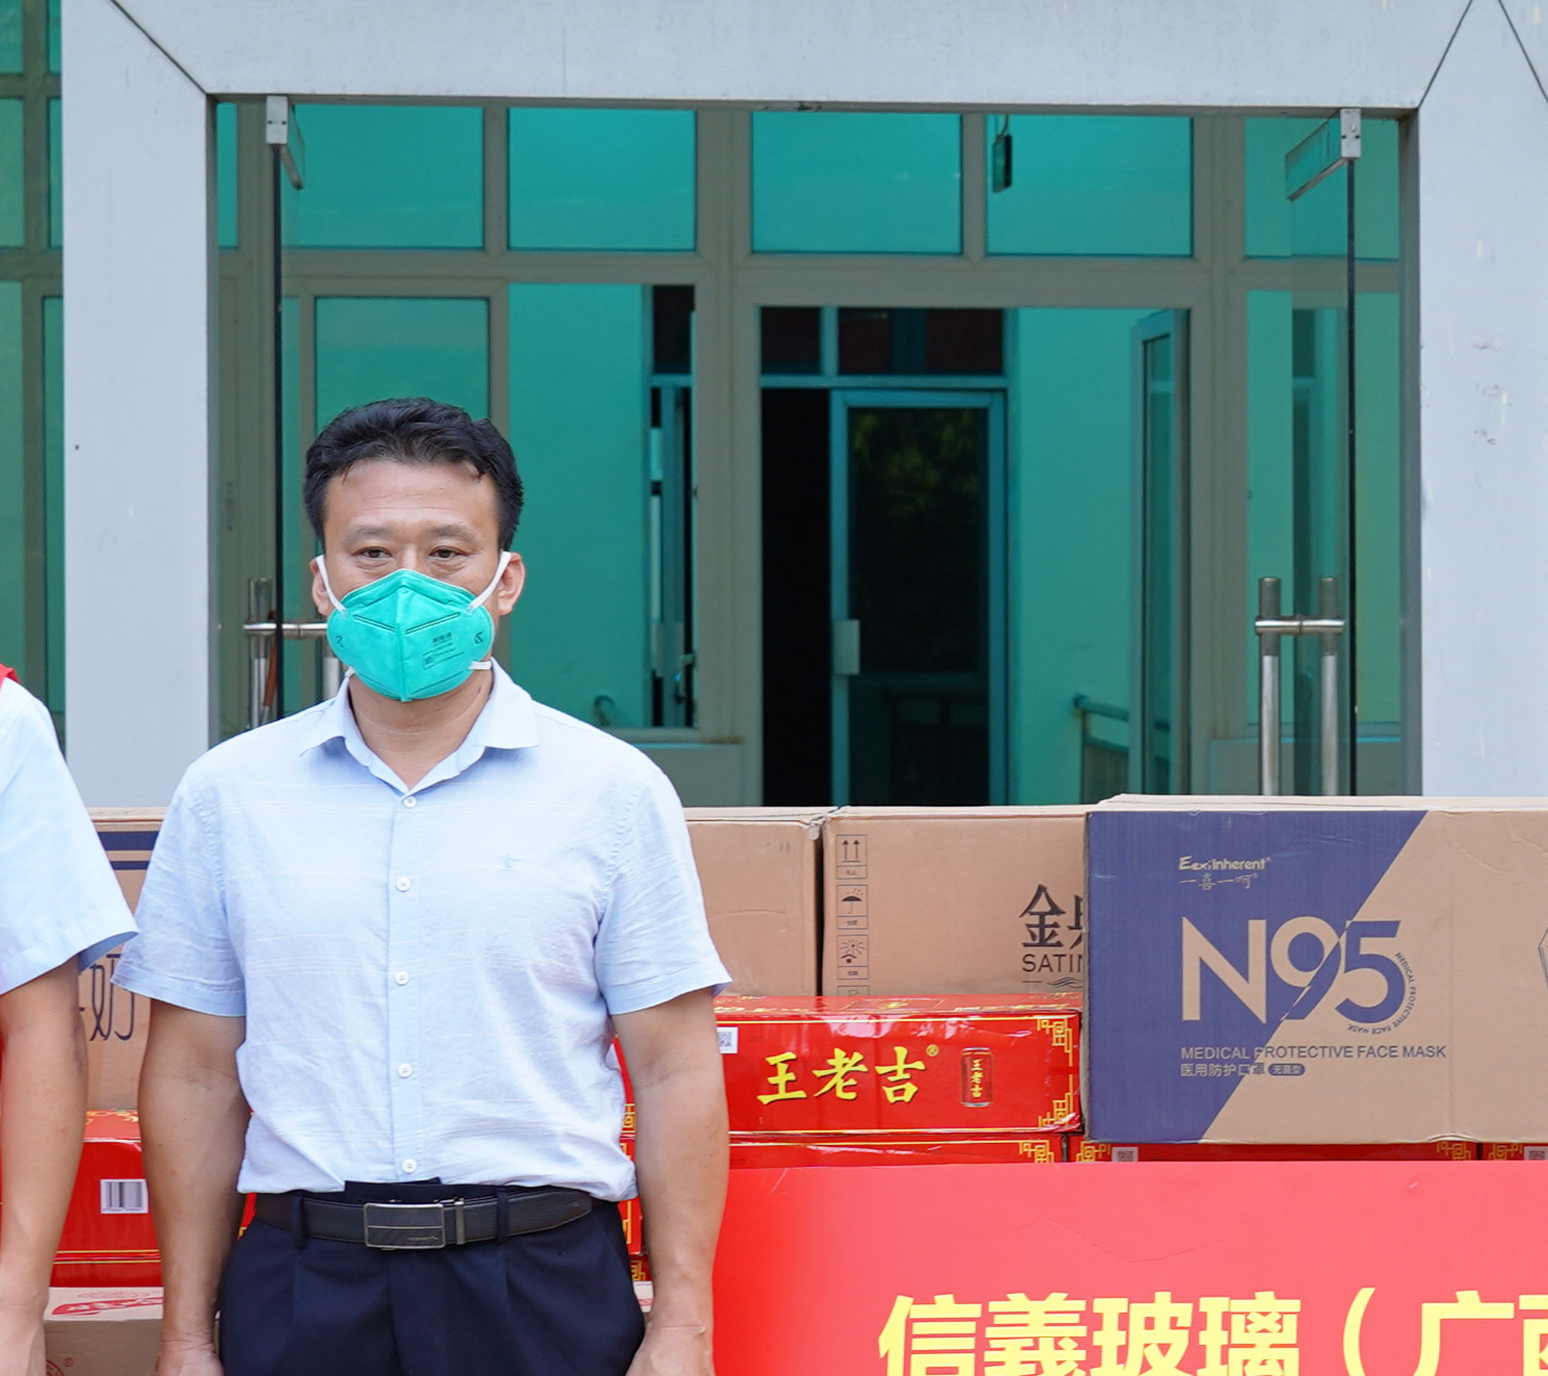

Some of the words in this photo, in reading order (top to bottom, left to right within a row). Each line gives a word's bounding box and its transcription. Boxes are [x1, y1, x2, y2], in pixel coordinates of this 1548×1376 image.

[1182, 916, 1406, 1024] N95
[757, 1047, 925, 1105] 王老吉
[1181, 1047, 1249, 1059] MEDICAL
[1254, 1046, 1353, 1058] PROTECTIVE
[1358, 1045, 1398, 1057] FACE
[1403, 1045, 1446, 1057] MASK
